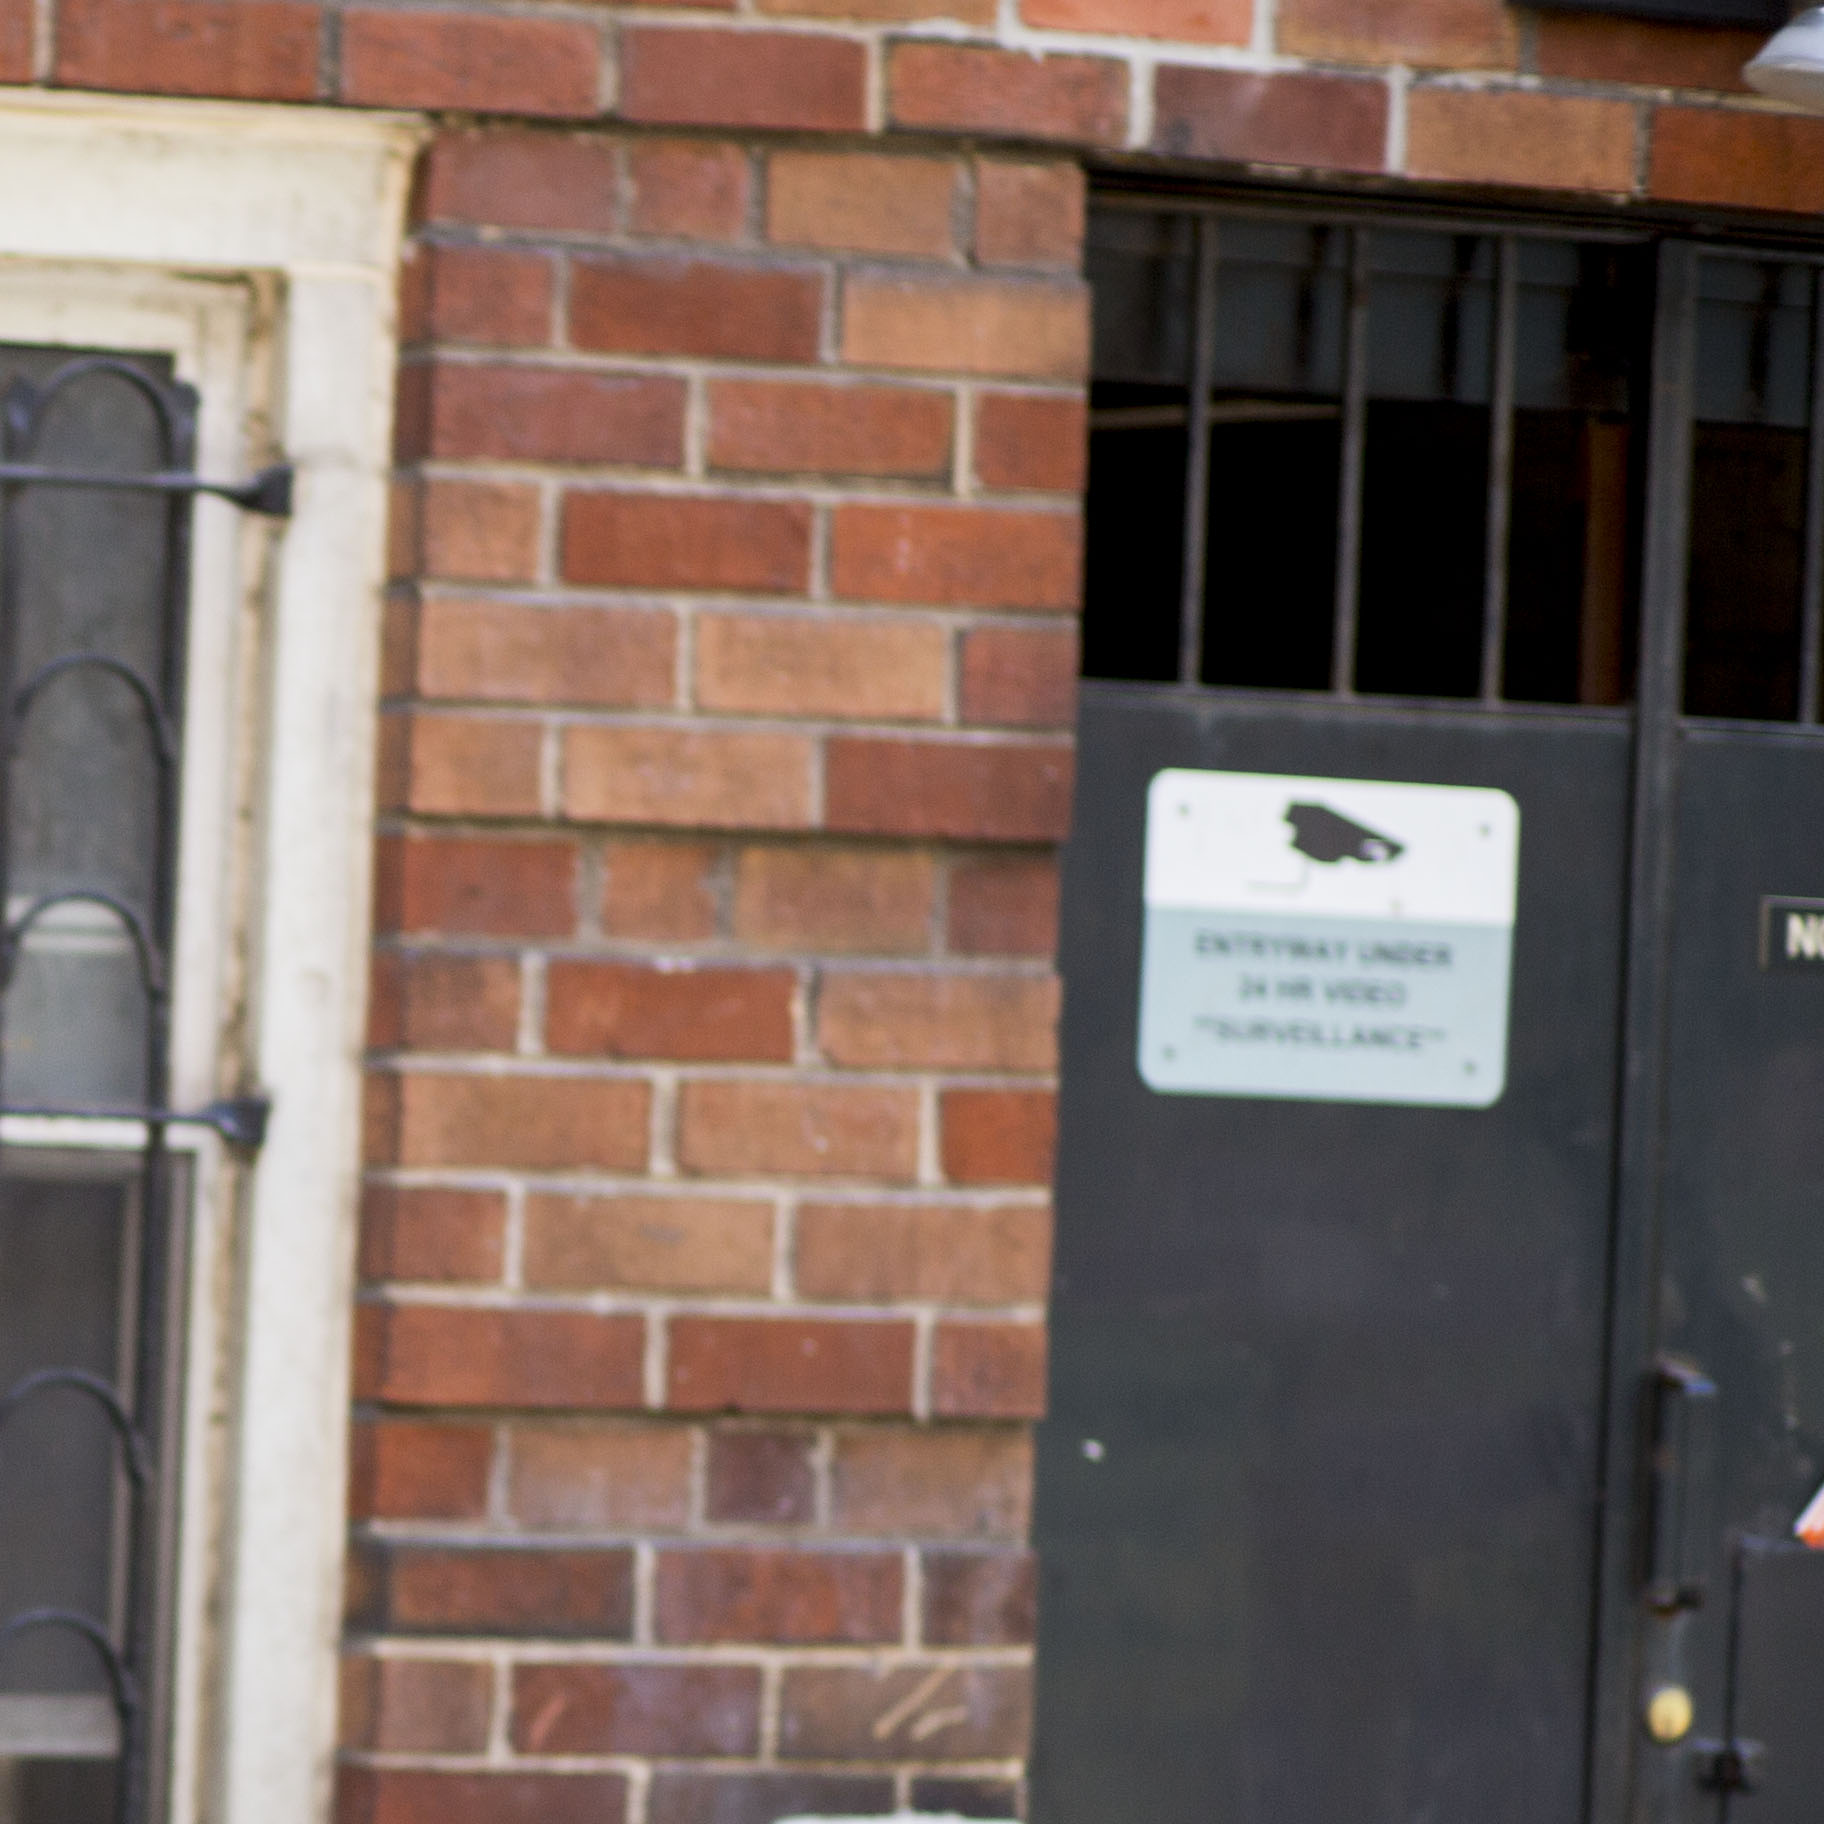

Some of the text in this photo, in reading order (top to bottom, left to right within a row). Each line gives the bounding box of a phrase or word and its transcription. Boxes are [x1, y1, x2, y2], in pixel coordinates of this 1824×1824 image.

[1194, 930, 1452, 968] ENTRYWAY UNDER
[1787, 913, 1824, 957] N
[1274, 978, 1312, 1001] HR
[1322, 980, 1406, 1006] VIDEO
